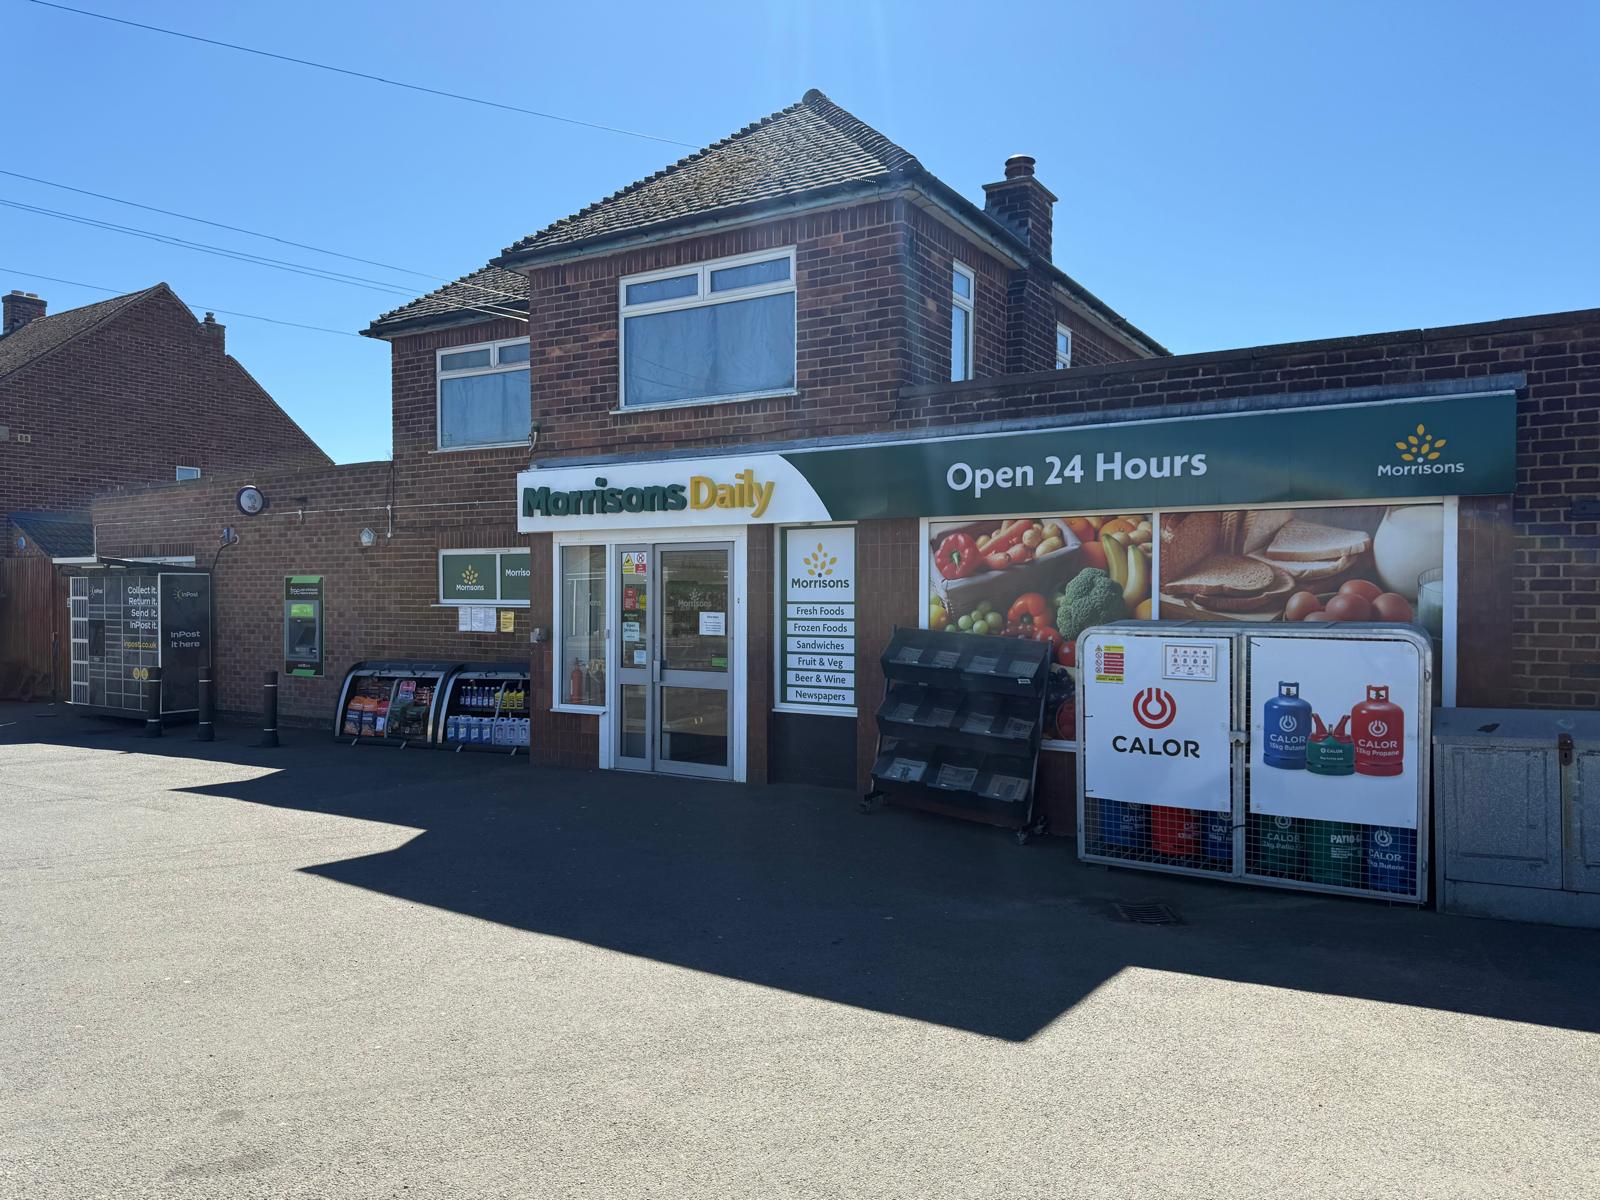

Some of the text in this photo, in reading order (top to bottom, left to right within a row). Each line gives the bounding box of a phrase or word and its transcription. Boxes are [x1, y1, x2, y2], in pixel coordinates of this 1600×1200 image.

[1377, 457, 1465, 477] Morrisons
[946, 451, 1208, 499] Open 24 Hours
[521, 468, 776, 519] Morrisons Daily
[791, 572, 850, 589] Morrisons
[127, 586, 151, 594] Collect
[131, 609, 149, 617] Send
[796, 606, 845, 616] Fresh Foods
[130, 621, 151, 629] InPost
[793, 623, 848, 633] Frozen Foods
[796, 640, 845, 650] Sandwiches
[797, 656, 844, 670] Fruit & Veg
[794, 673, 846, 684] Beer & Wine
[795, 690, 846, 702] Newspapers
[1270, 733, 1306, 744] CALOR
[1358, 739, 1398, 749] CALOR
[1112, 735, 1200, 759] CALOR
